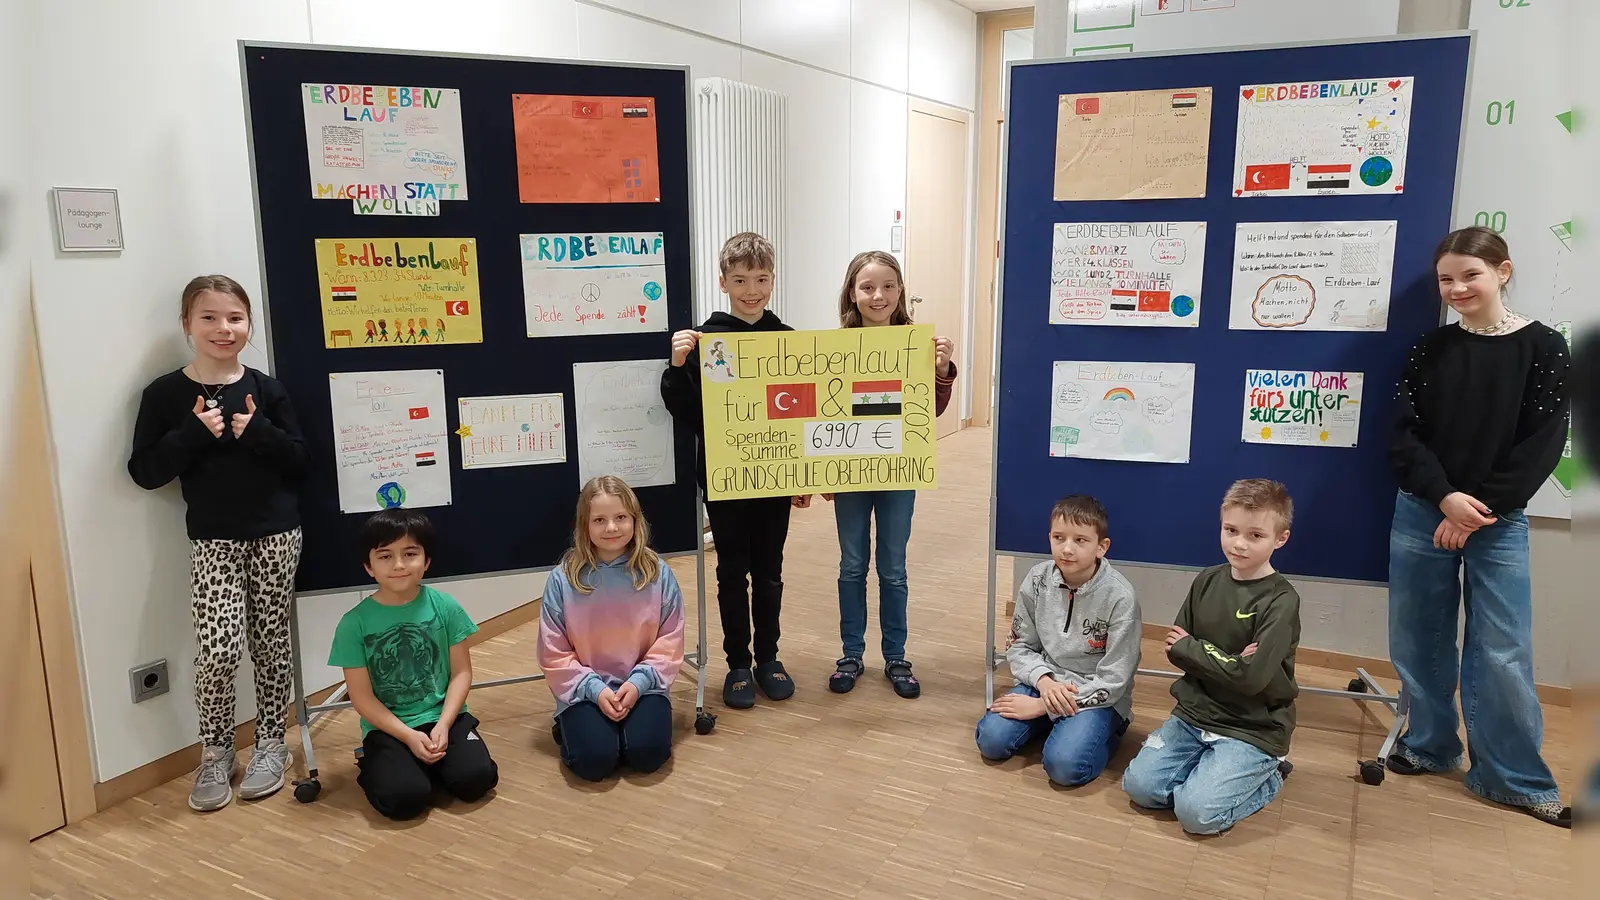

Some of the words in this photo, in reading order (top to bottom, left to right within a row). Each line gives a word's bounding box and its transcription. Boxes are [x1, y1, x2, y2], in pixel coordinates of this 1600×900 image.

[1256, 82, 1378, 102] ERDBEBENLAUF
[343, 107, 398, 122] LAUF
[1486, 100, 1515, 126] 01
[317, 184, 397, 199] MACHEN
[404, 182, 459, 199] STATT
[67, 208, 110, 218] Pädagogen-
[355, 198, 436, 216] WOLLEN
[77, 221, 103, 231] lounge
[1067, 223, 1178, 239] ERDBEBENLAUF
[1247, 233, 1266, 242] Helft
[1314, 229, 1323, 239] für
[1324, 230, 1336, 239] den
[522, 235, 662, 262] ERDBEBENLAUF
[435, 281, 466, 292] Turnhalle
[1127, 280, 1174, 290] MINUTEN
[1272, 281, 1301, 294] Motto:
[1288, 298, 1309, 306] nicht
[534, 305, 563, 323] Jede
[574, 305, 605, 326] Spende
[738, 329, 918, 379] Erdbebenlauf
[1249, 370, 1306, 388] Vielen
[1312, 371, 1348, 390] Dank
[723, 389, 762, 423] für
[821, 378, 848, 418] &
[1250, 388, 1284, 408] fürs
[471, 404, 522, 425] DANKE
[903, 381, 931, 444] 2023
[471, 435, 512, 456] EURE
[517, 431, 559, 453] HILFE
[725, 425, 797, 452] Spenden-
[812, 422, 862, 449] 6990
[872, 422, 894, 449] €
[711, 460, 822, 493] GRUNDSCHULE
[825, 455, 935, 485] OBERFÖHRING
